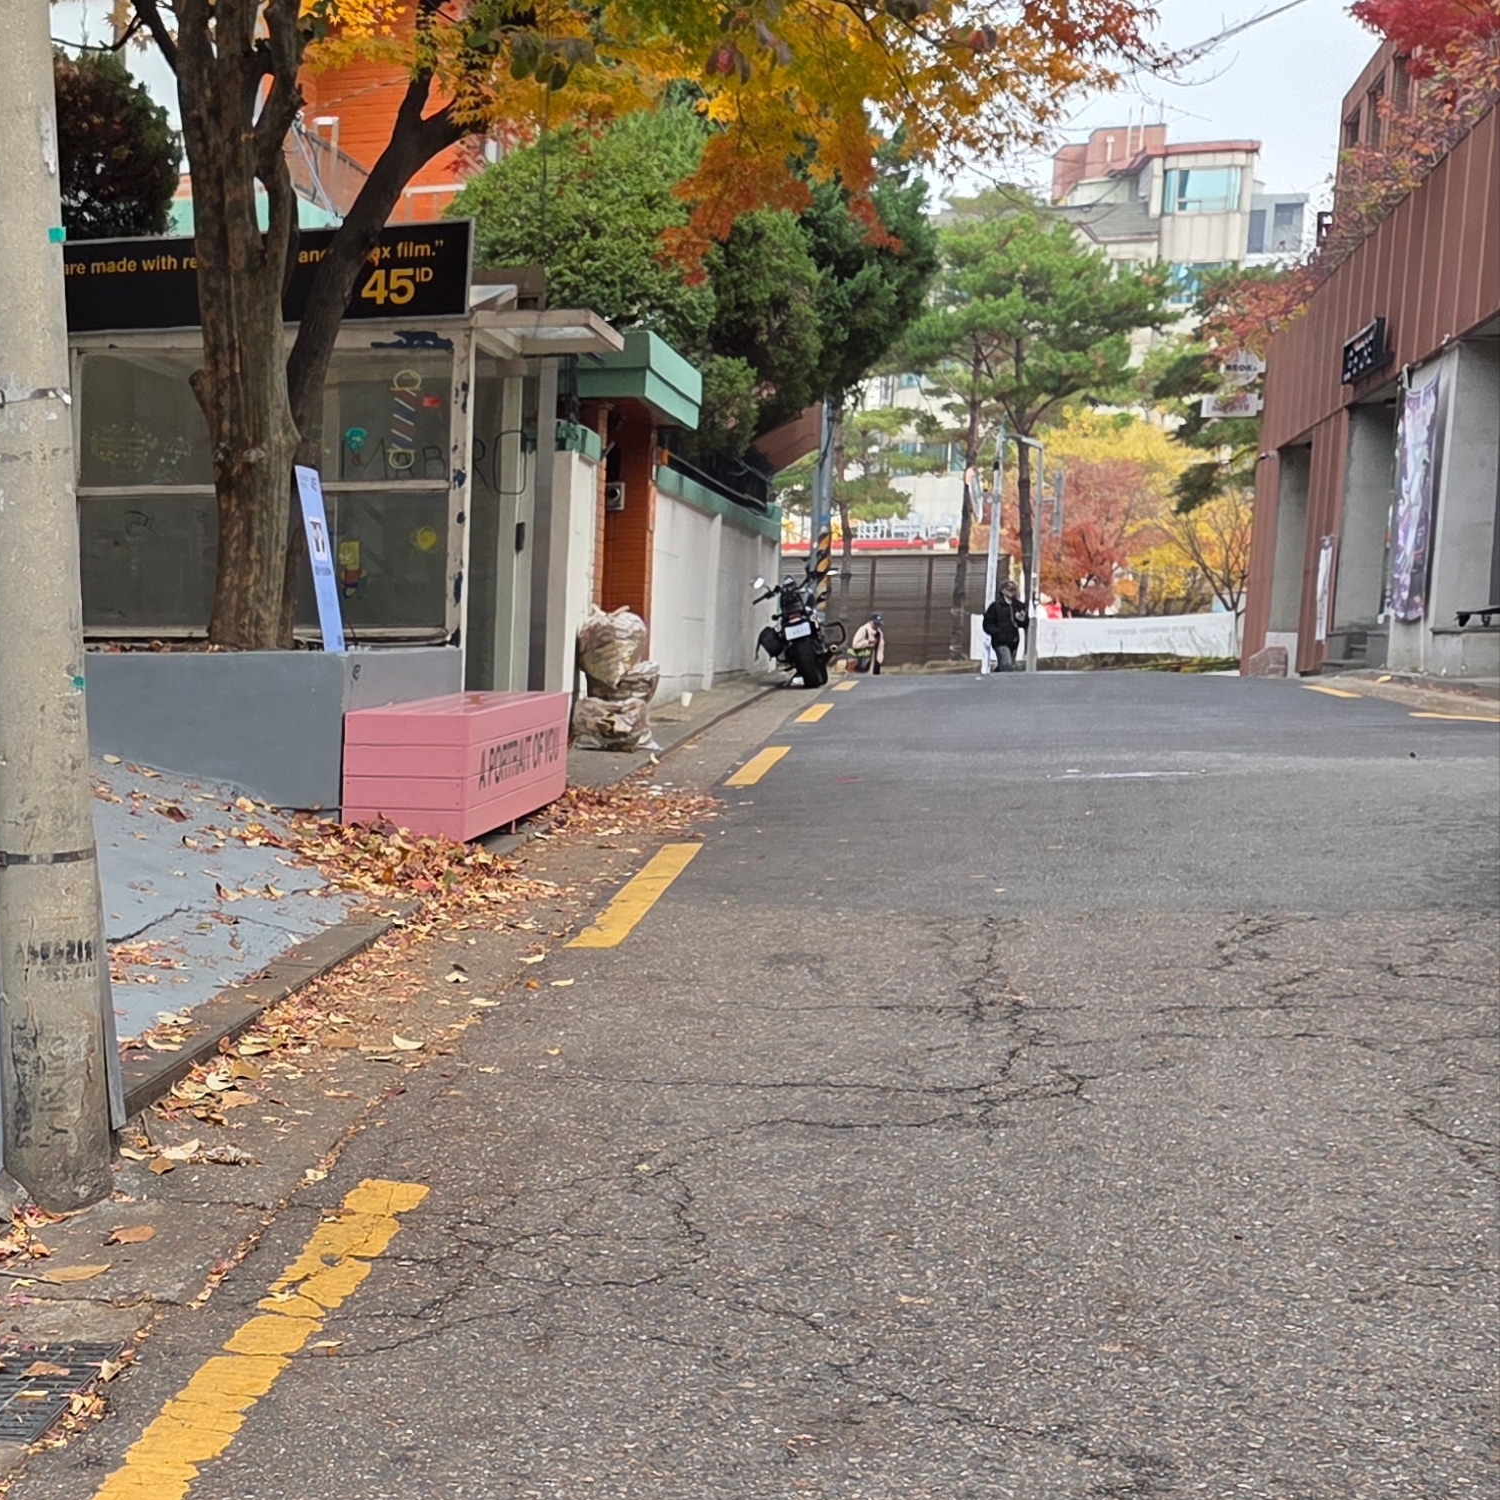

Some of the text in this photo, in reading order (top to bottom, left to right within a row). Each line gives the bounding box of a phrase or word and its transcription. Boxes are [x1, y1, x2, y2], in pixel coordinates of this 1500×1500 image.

[91, 257, 137, 274] made
[143, 254, 177, 272] with
[478, 749, 487, 791] A
